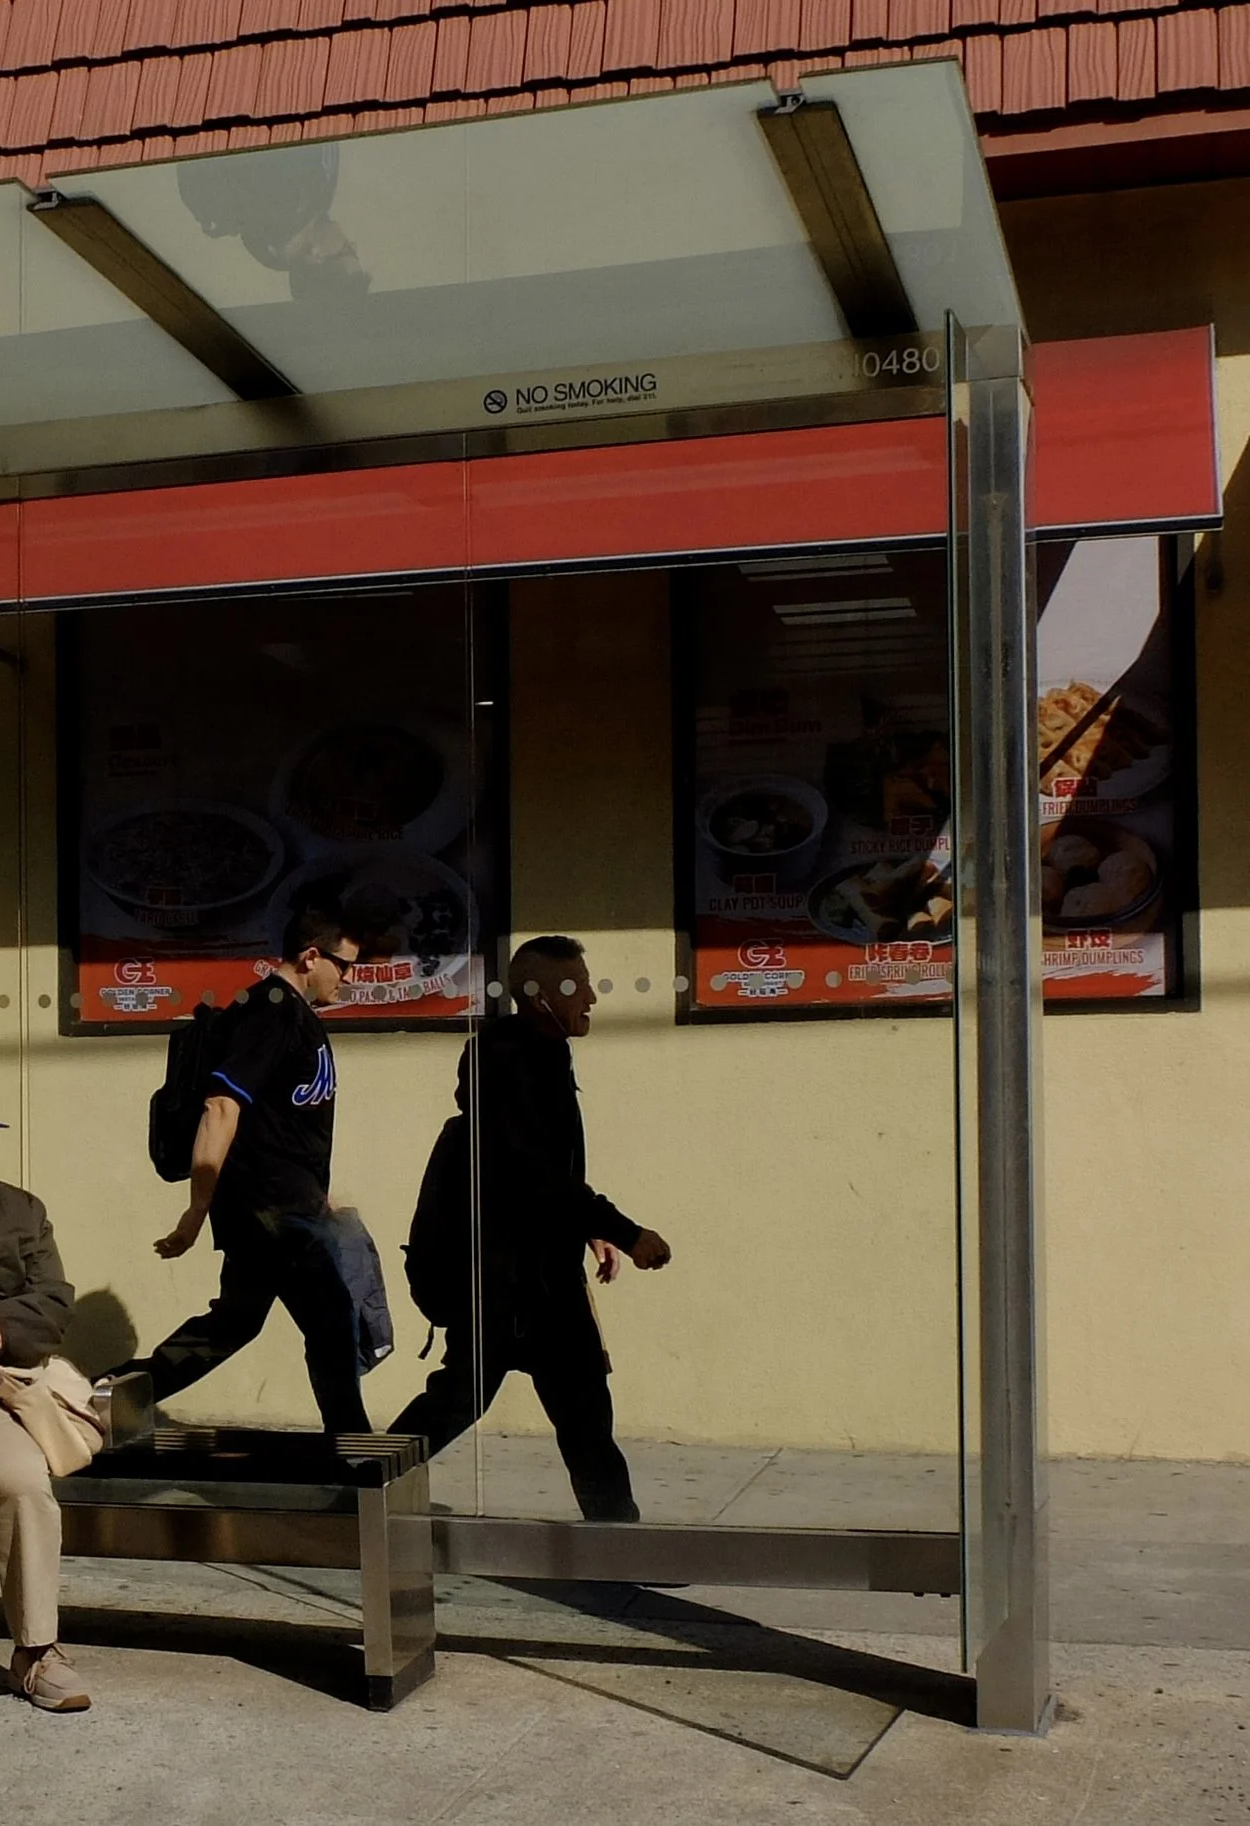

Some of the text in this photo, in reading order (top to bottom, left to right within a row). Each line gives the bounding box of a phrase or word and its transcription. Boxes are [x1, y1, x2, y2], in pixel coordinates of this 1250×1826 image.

[516, 373, 657, 405] NO SMOKING
[1082, 950, 1144, 965] DUMPLINGS
